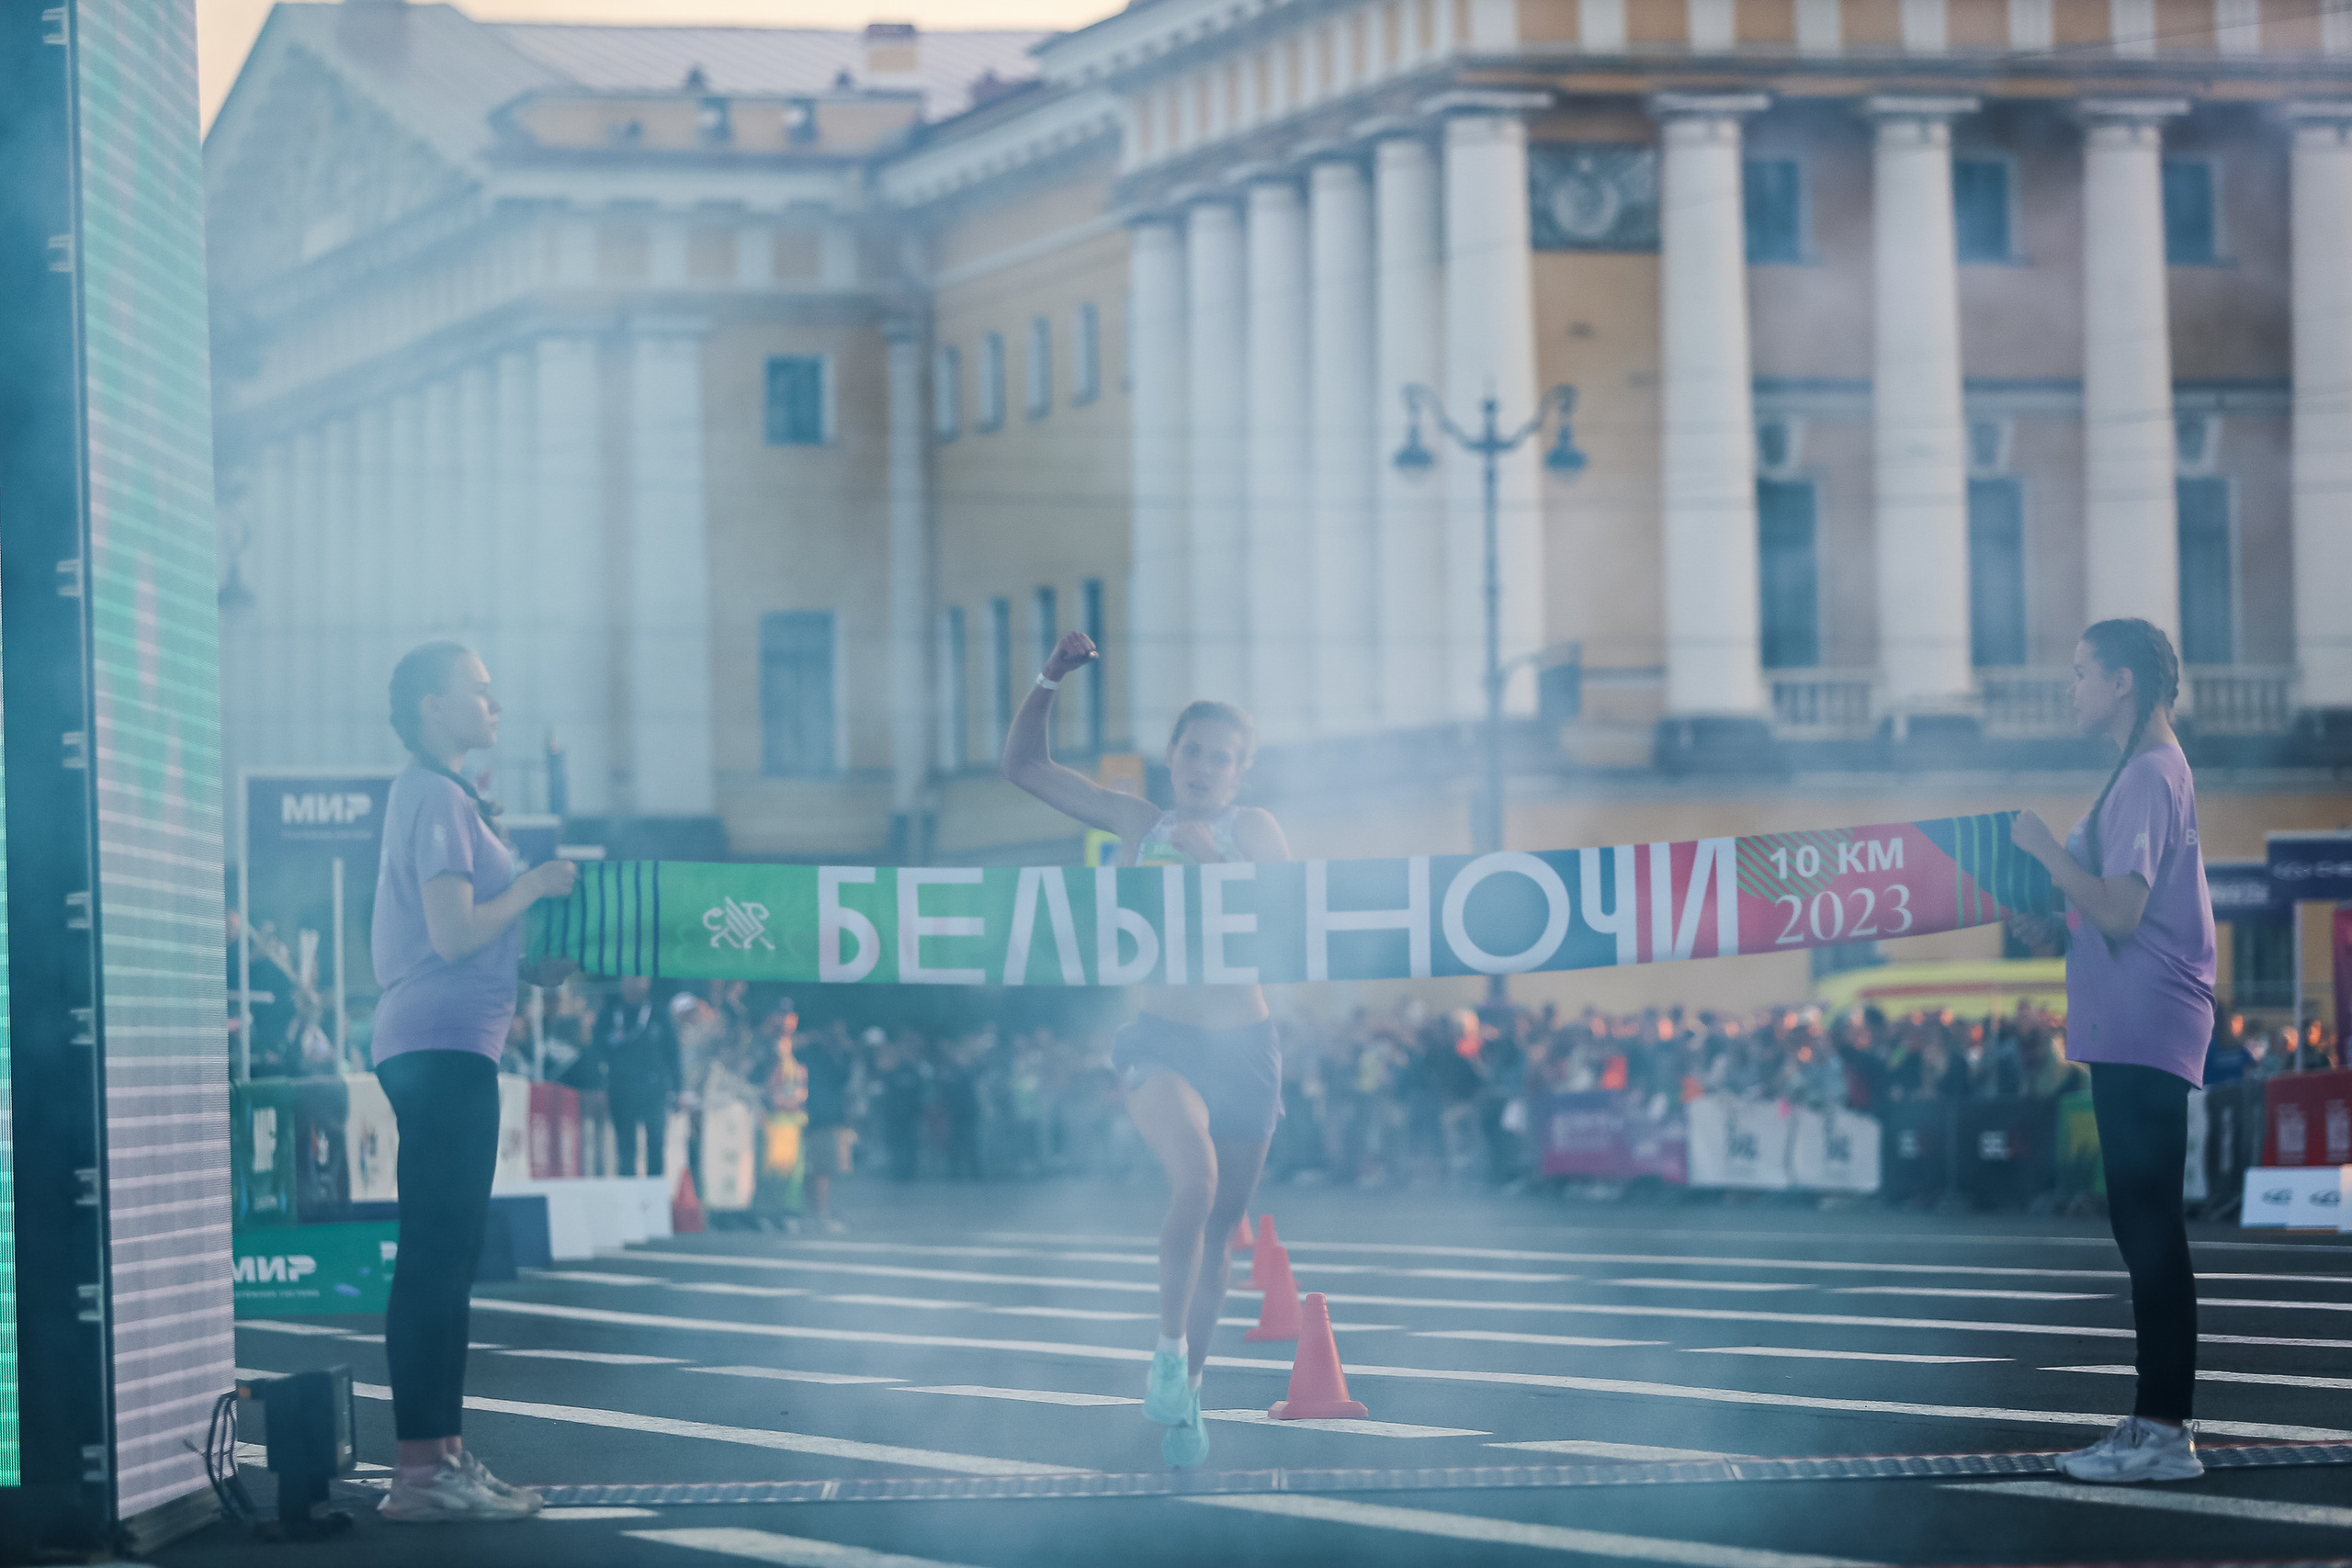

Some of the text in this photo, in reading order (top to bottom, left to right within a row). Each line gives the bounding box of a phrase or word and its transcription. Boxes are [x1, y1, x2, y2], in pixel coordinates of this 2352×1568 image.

[281, 793, 372, 824] МИР
[1770, 837, 1905, 879] 10 КМ
[817, 836, 1739, 986] БЕЛЫЕ НОЧИ
[1774, 884, 1914, 944] 2023
